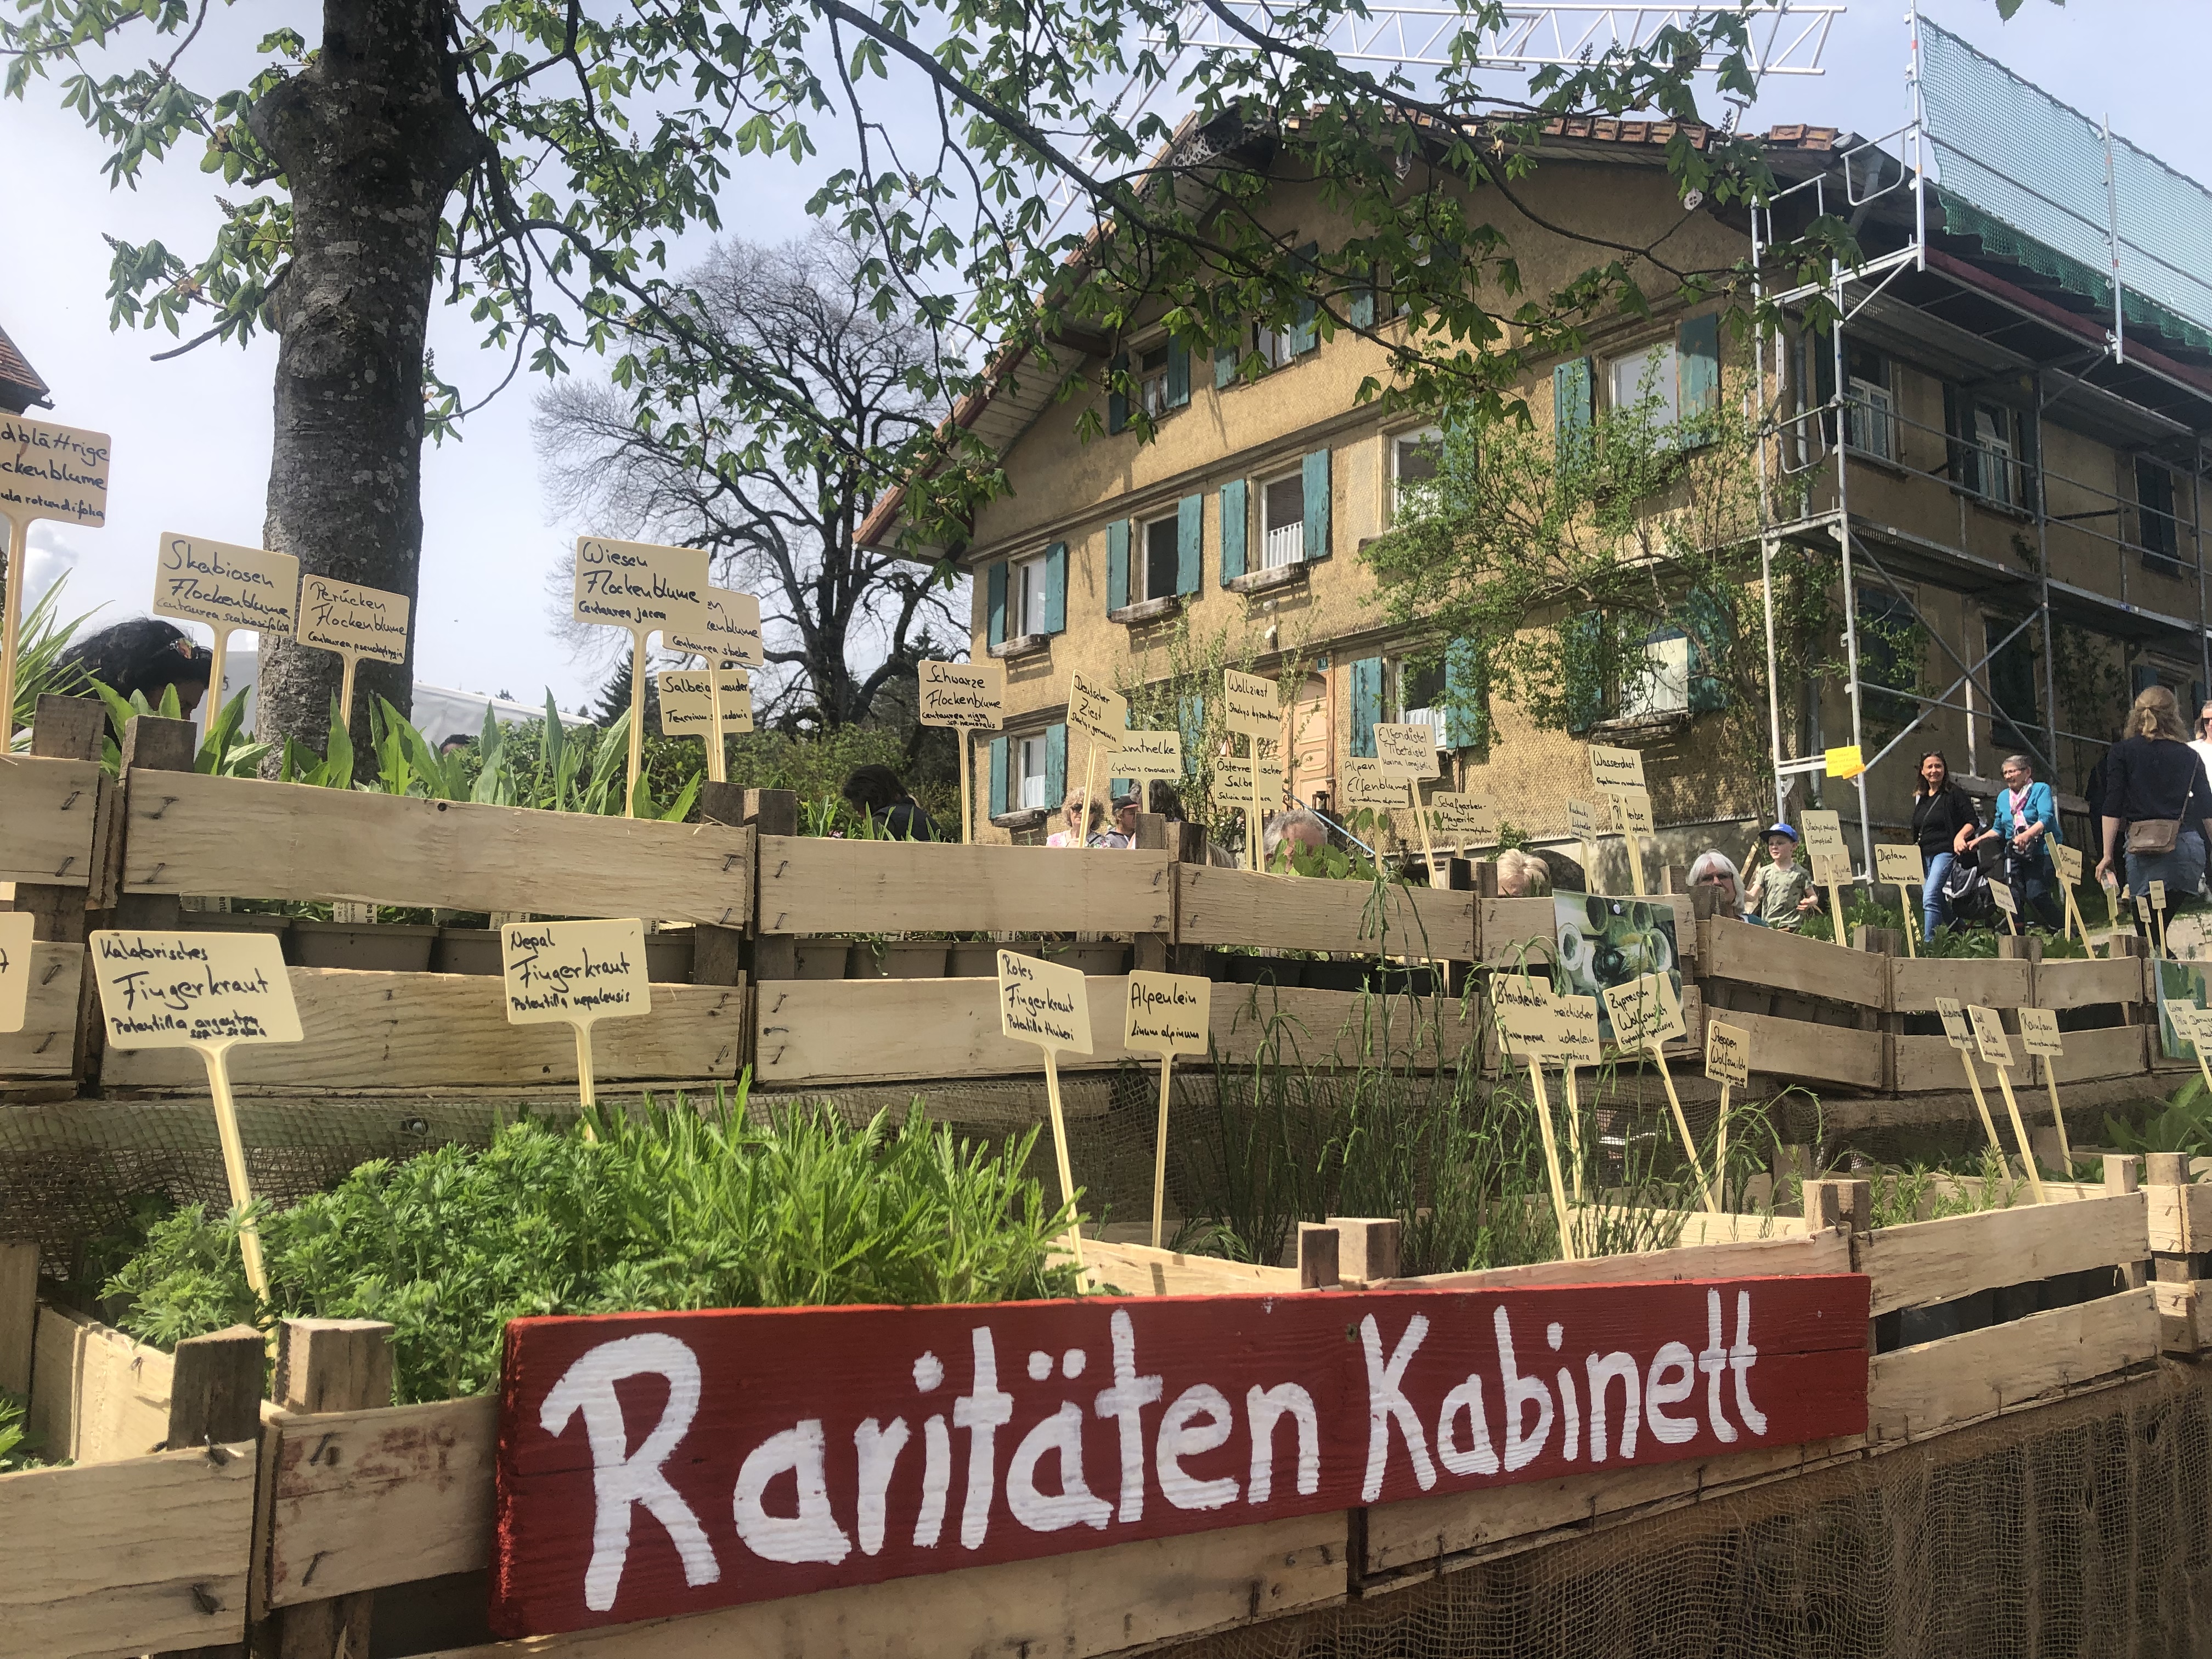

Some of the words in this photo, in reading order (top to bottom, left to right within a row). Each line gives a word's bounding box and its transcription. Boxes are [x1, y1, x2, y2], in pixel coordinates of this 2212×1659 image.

[0, 453, 107, 490] ckenblume
[164, 540, 274, 588] Skabiosen
[583, 541, 648, 567] Wiesen
[168, 579, 291, 619] Flockenblume
[310, 582, 387, 612] Perücken
[583, 570, 700, 603] Flockenblume
[311, 603, 407, 635] Flockenblume
[926, 665, 985, 688] Schwarze
[1074, 675, 1110, 704] Deutscher
[1228, 673, 1268, 698] Wollziest
[926, 690, 1002, 708] Flockenblume
[1079, 697, 1102, 720] Ziest
[1224, 776, 1253, 787] Salbe
[1345, 761, 1376, 776] Alpen
[1347, 777, 1408, 797] Elfenblume
[511, 928, 555, 954] Nepal
[510, 947, 630, 993] Fingerkraut
[1002, 953, 1034, 980] Rotes
[112, 964, 269, 1010] Fingerkraut
[1005, 983, 1074, 1017] Fingerkraut
[1131, 982, 1197, 1014] Alpenlein
[511, 993, 568, 1011] Potentilla
[111, 1014, 188, 1035] Potentilla
[1131, 1019, 1158, 1037] Linum
[1161, 1022, 1199, 1045] alpinum
[1711, 1025, 1737, 1050] Steppen
[1711, 1045, 1745, 1072] Wolfsmilch
[540, 1308, 1319, 1609] Raritäten
[1363, 1289, 1768, 1502] Kabinett
